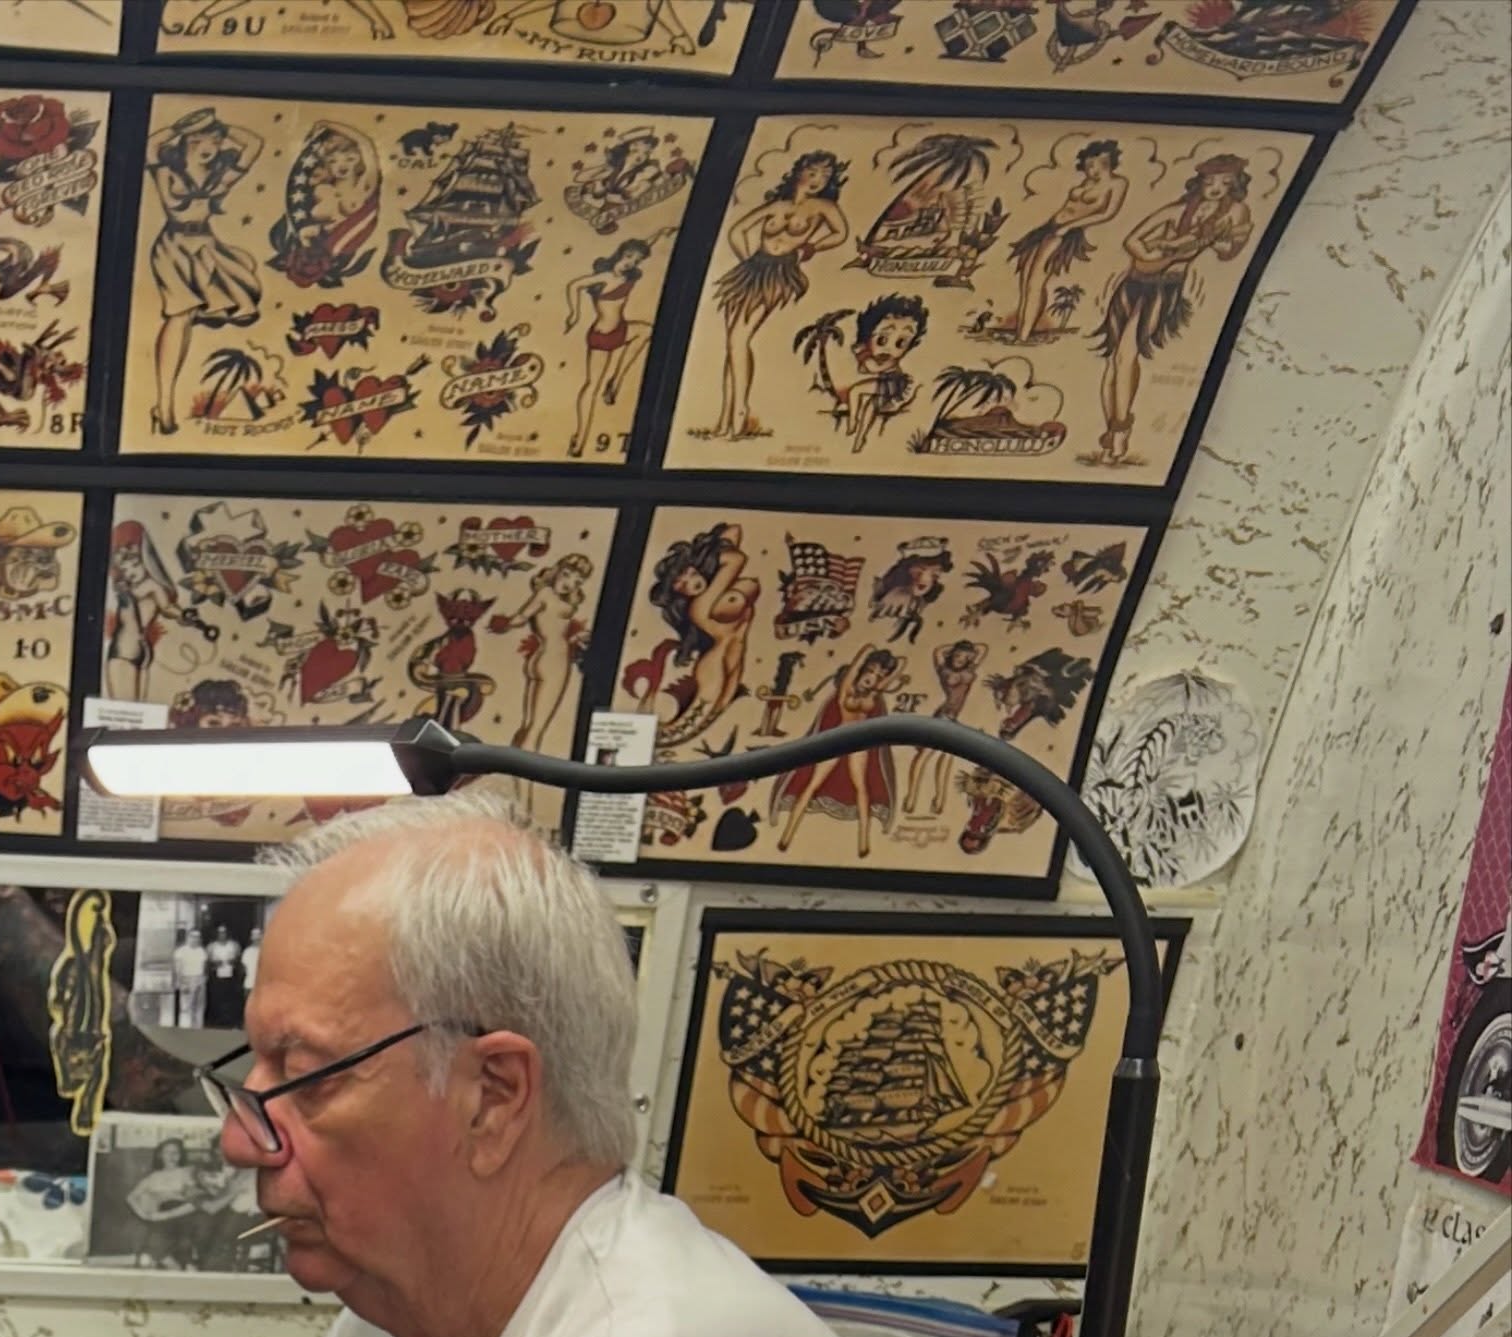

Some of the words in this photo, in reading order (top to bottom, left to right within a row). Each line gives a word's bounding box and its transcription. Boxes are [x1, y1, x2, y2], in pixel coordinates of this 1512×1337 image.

[527, 34, 572, 54] MY
[577, 46, 649, 63] RUIN
[1171, 31, 1266, 73] HOMEWARD
[449, 368, 530, 398] NAME
[317, 391, 397, 422] NAME
[929, 437, 1048, 453] HONOLULU
